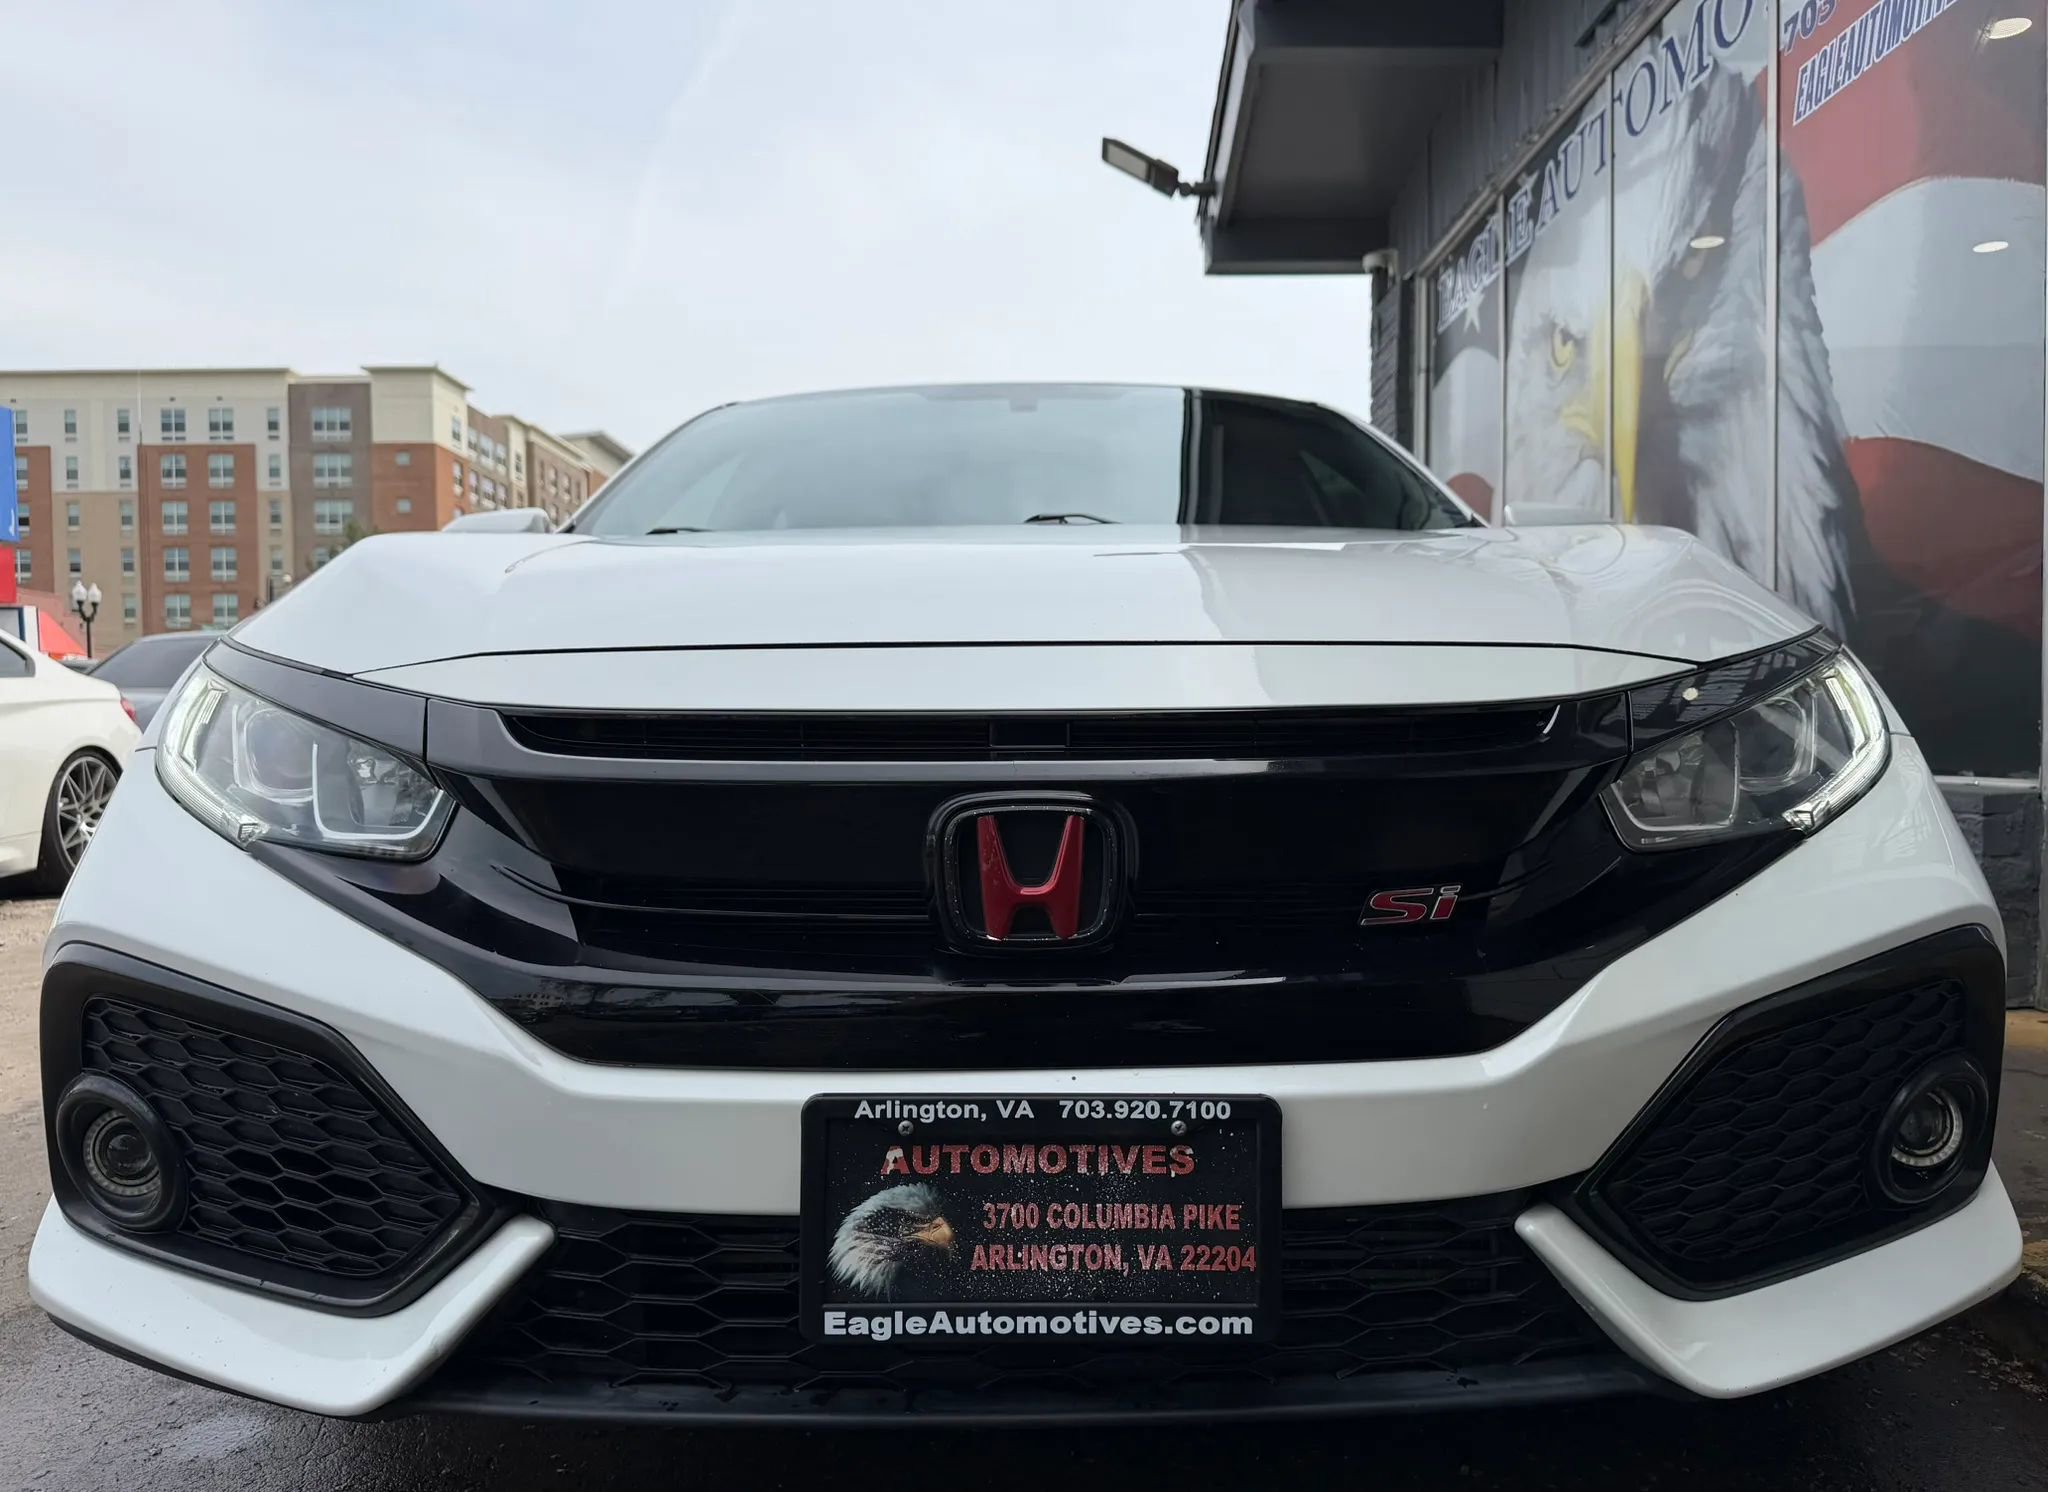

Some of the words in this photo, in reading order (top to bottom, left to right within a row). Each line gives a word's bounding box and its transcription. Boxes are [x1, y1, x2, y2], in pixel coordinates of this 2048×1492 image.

[1437, 183, 1535, 335] EAGLE
[1535, 0, 1769, 236] AUTOMO
[1360, 885, 1461, 926] Si
[854, 1099, 987, 1124] Arlington,
[995, 1099, 1035, 1119] VA
[1058, 1099, 1231, 1120] 703.920.7100
[880, 1143, 1196, 1177] AUTOMOTIVES
[982, 1202, 1040, 1230] 3700
[1046, 1202, 1176, 1231] COLUMBIA
[1183, 1203, 1240, 1231] PIKE
[970, 1244, 1130, 1277] ARLINGTON,
[1137, 1244, 1173, 1271] VA
[1180, 1245, 1257, 1272] 22204
[823, 1310, 1254, 1341] EagleAutomotives.com
